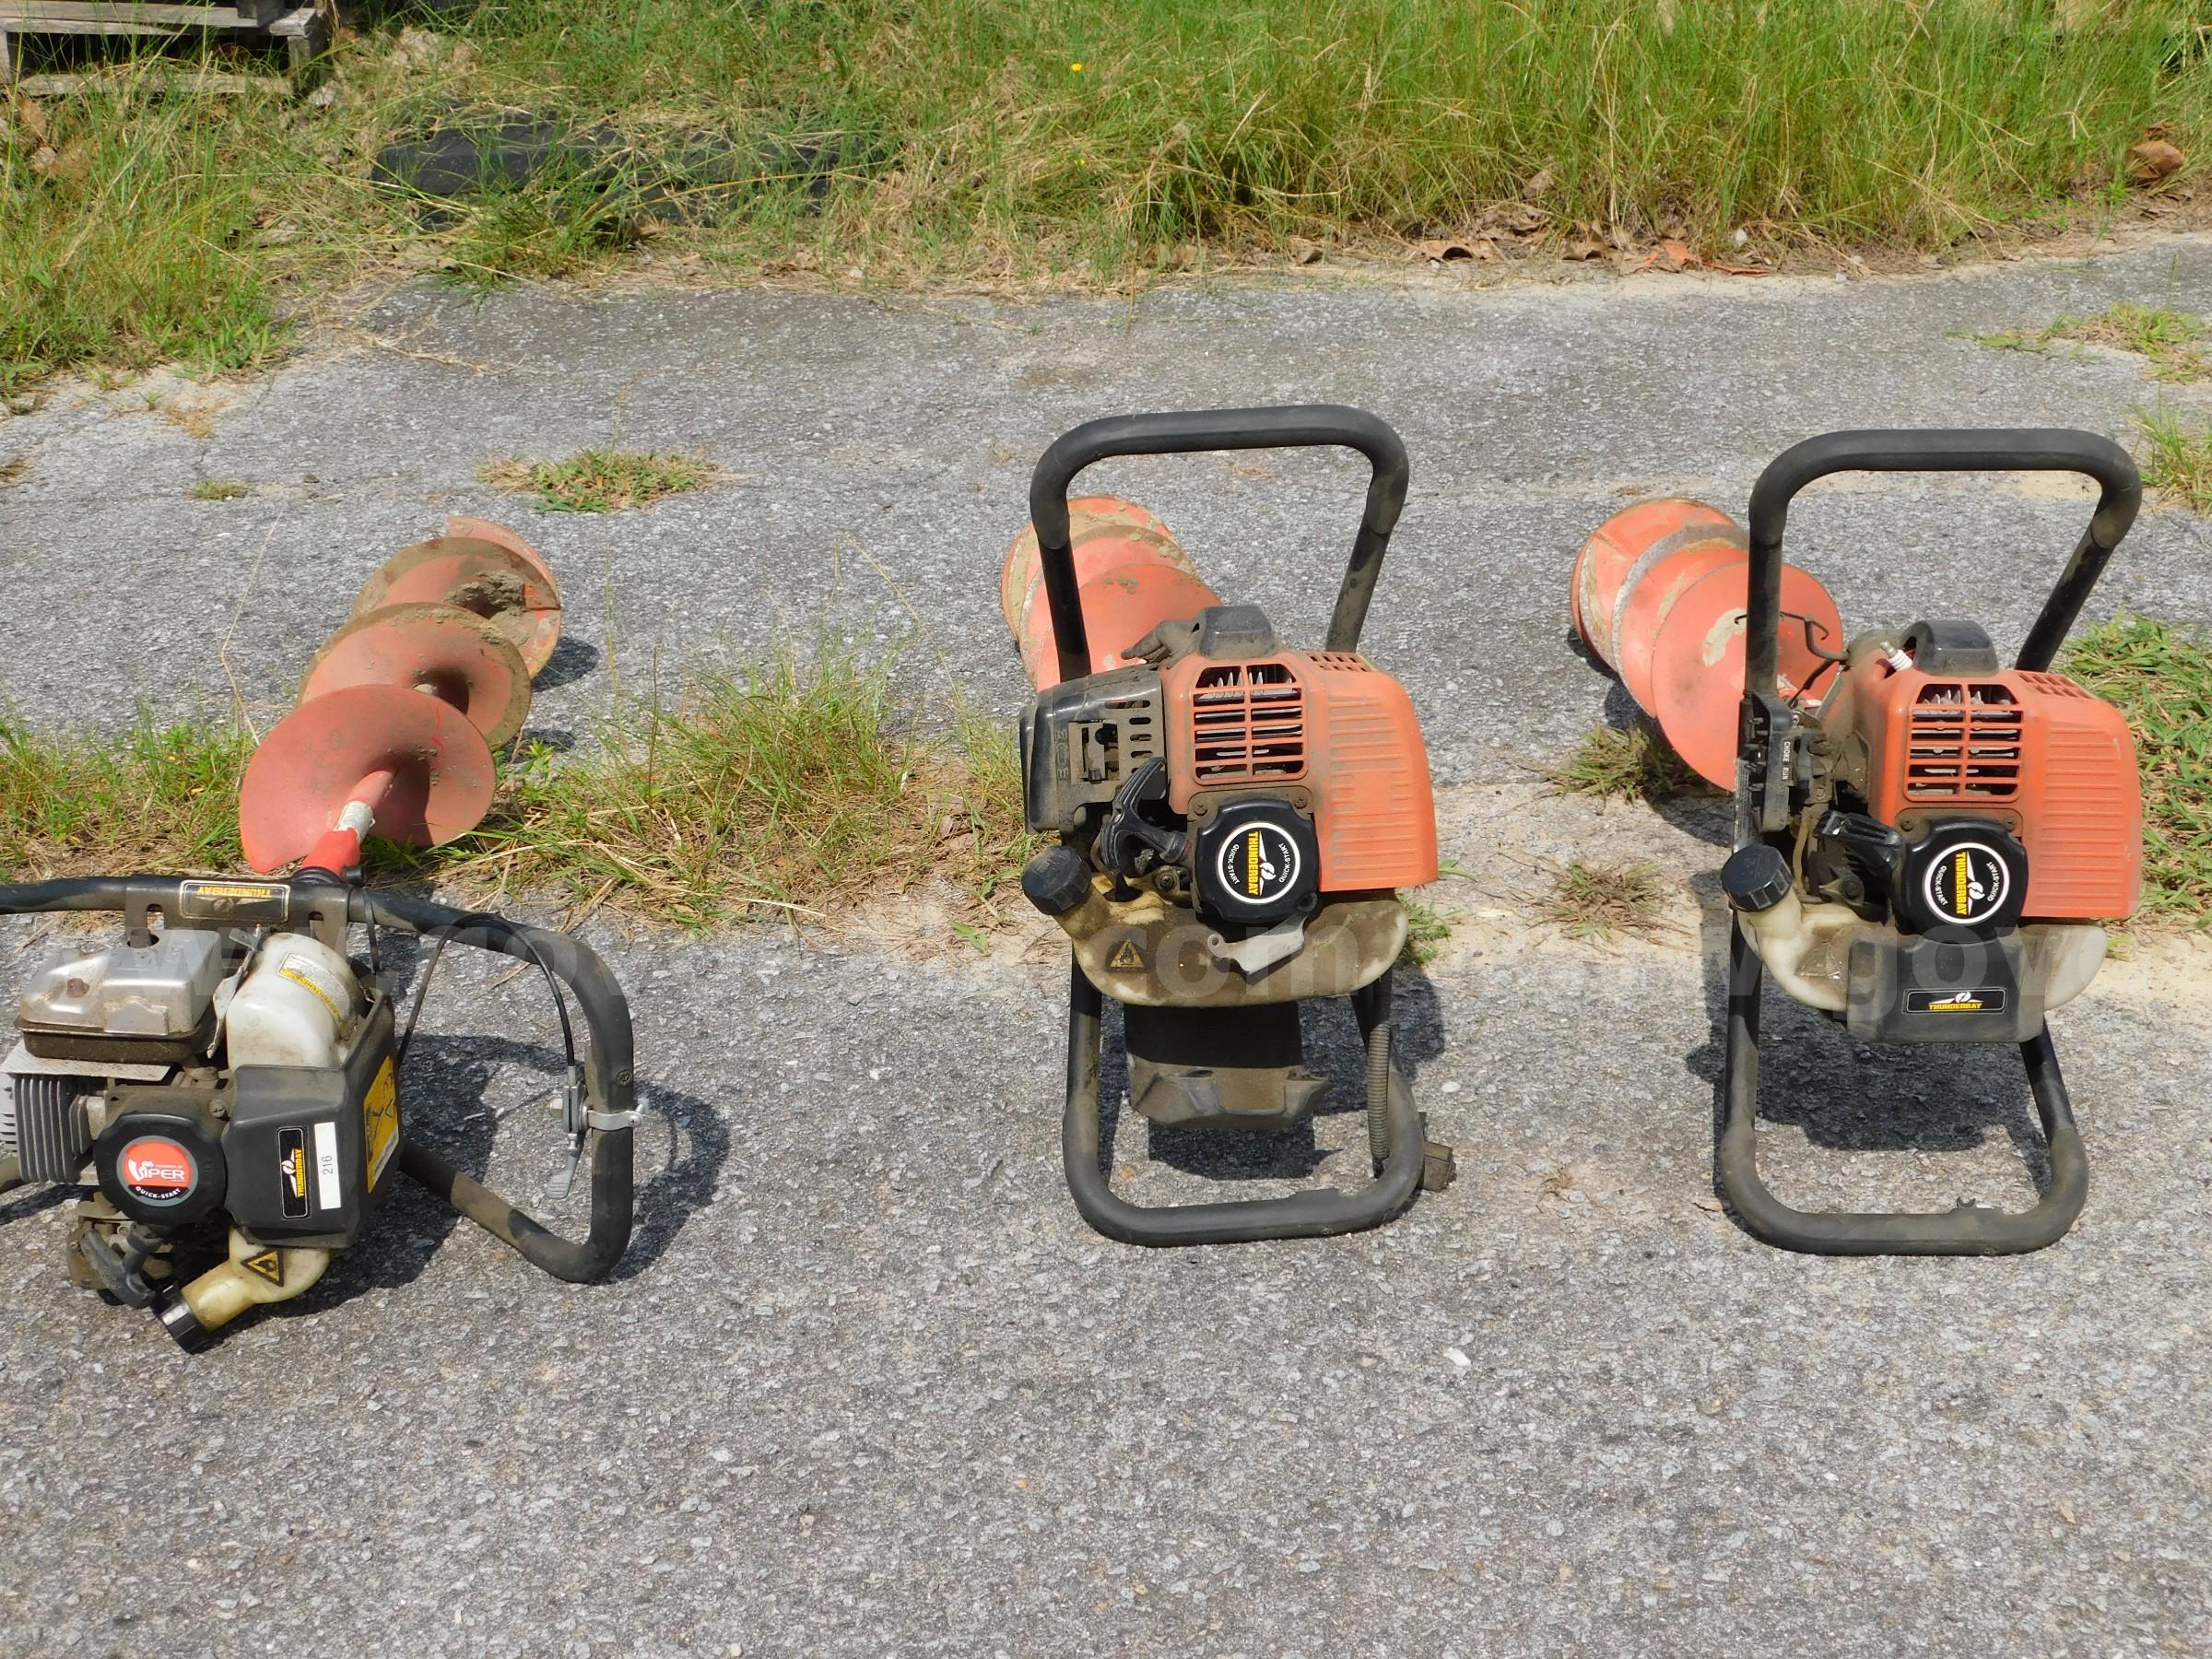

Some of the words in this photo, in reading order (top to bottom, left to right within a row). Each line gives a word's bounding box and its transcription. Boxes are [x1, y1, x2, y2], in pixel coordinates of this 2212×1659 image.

[1228, 843, 1241, 884] QUICK-START
[1248, 831, 1259, 895] THUNDERBAY
[1278, 842, 1291, 883] QUICK-START
[1955, 851, 1968, 915] THUNDERBAY
[1986, 861, 2000, 901] QUICK-START
[1936, 865, 1948, 906] QUICK-START
[1928, 1003, 1983, 1011] THUNDERBAY
[128, 1159, 185, 1182] VIPER
[294, 1148, 305, 1198] THUNDERBAY
[321, 1155, 334, 1175] 216
[135, 1186, 182, 1199] QUICK-START
